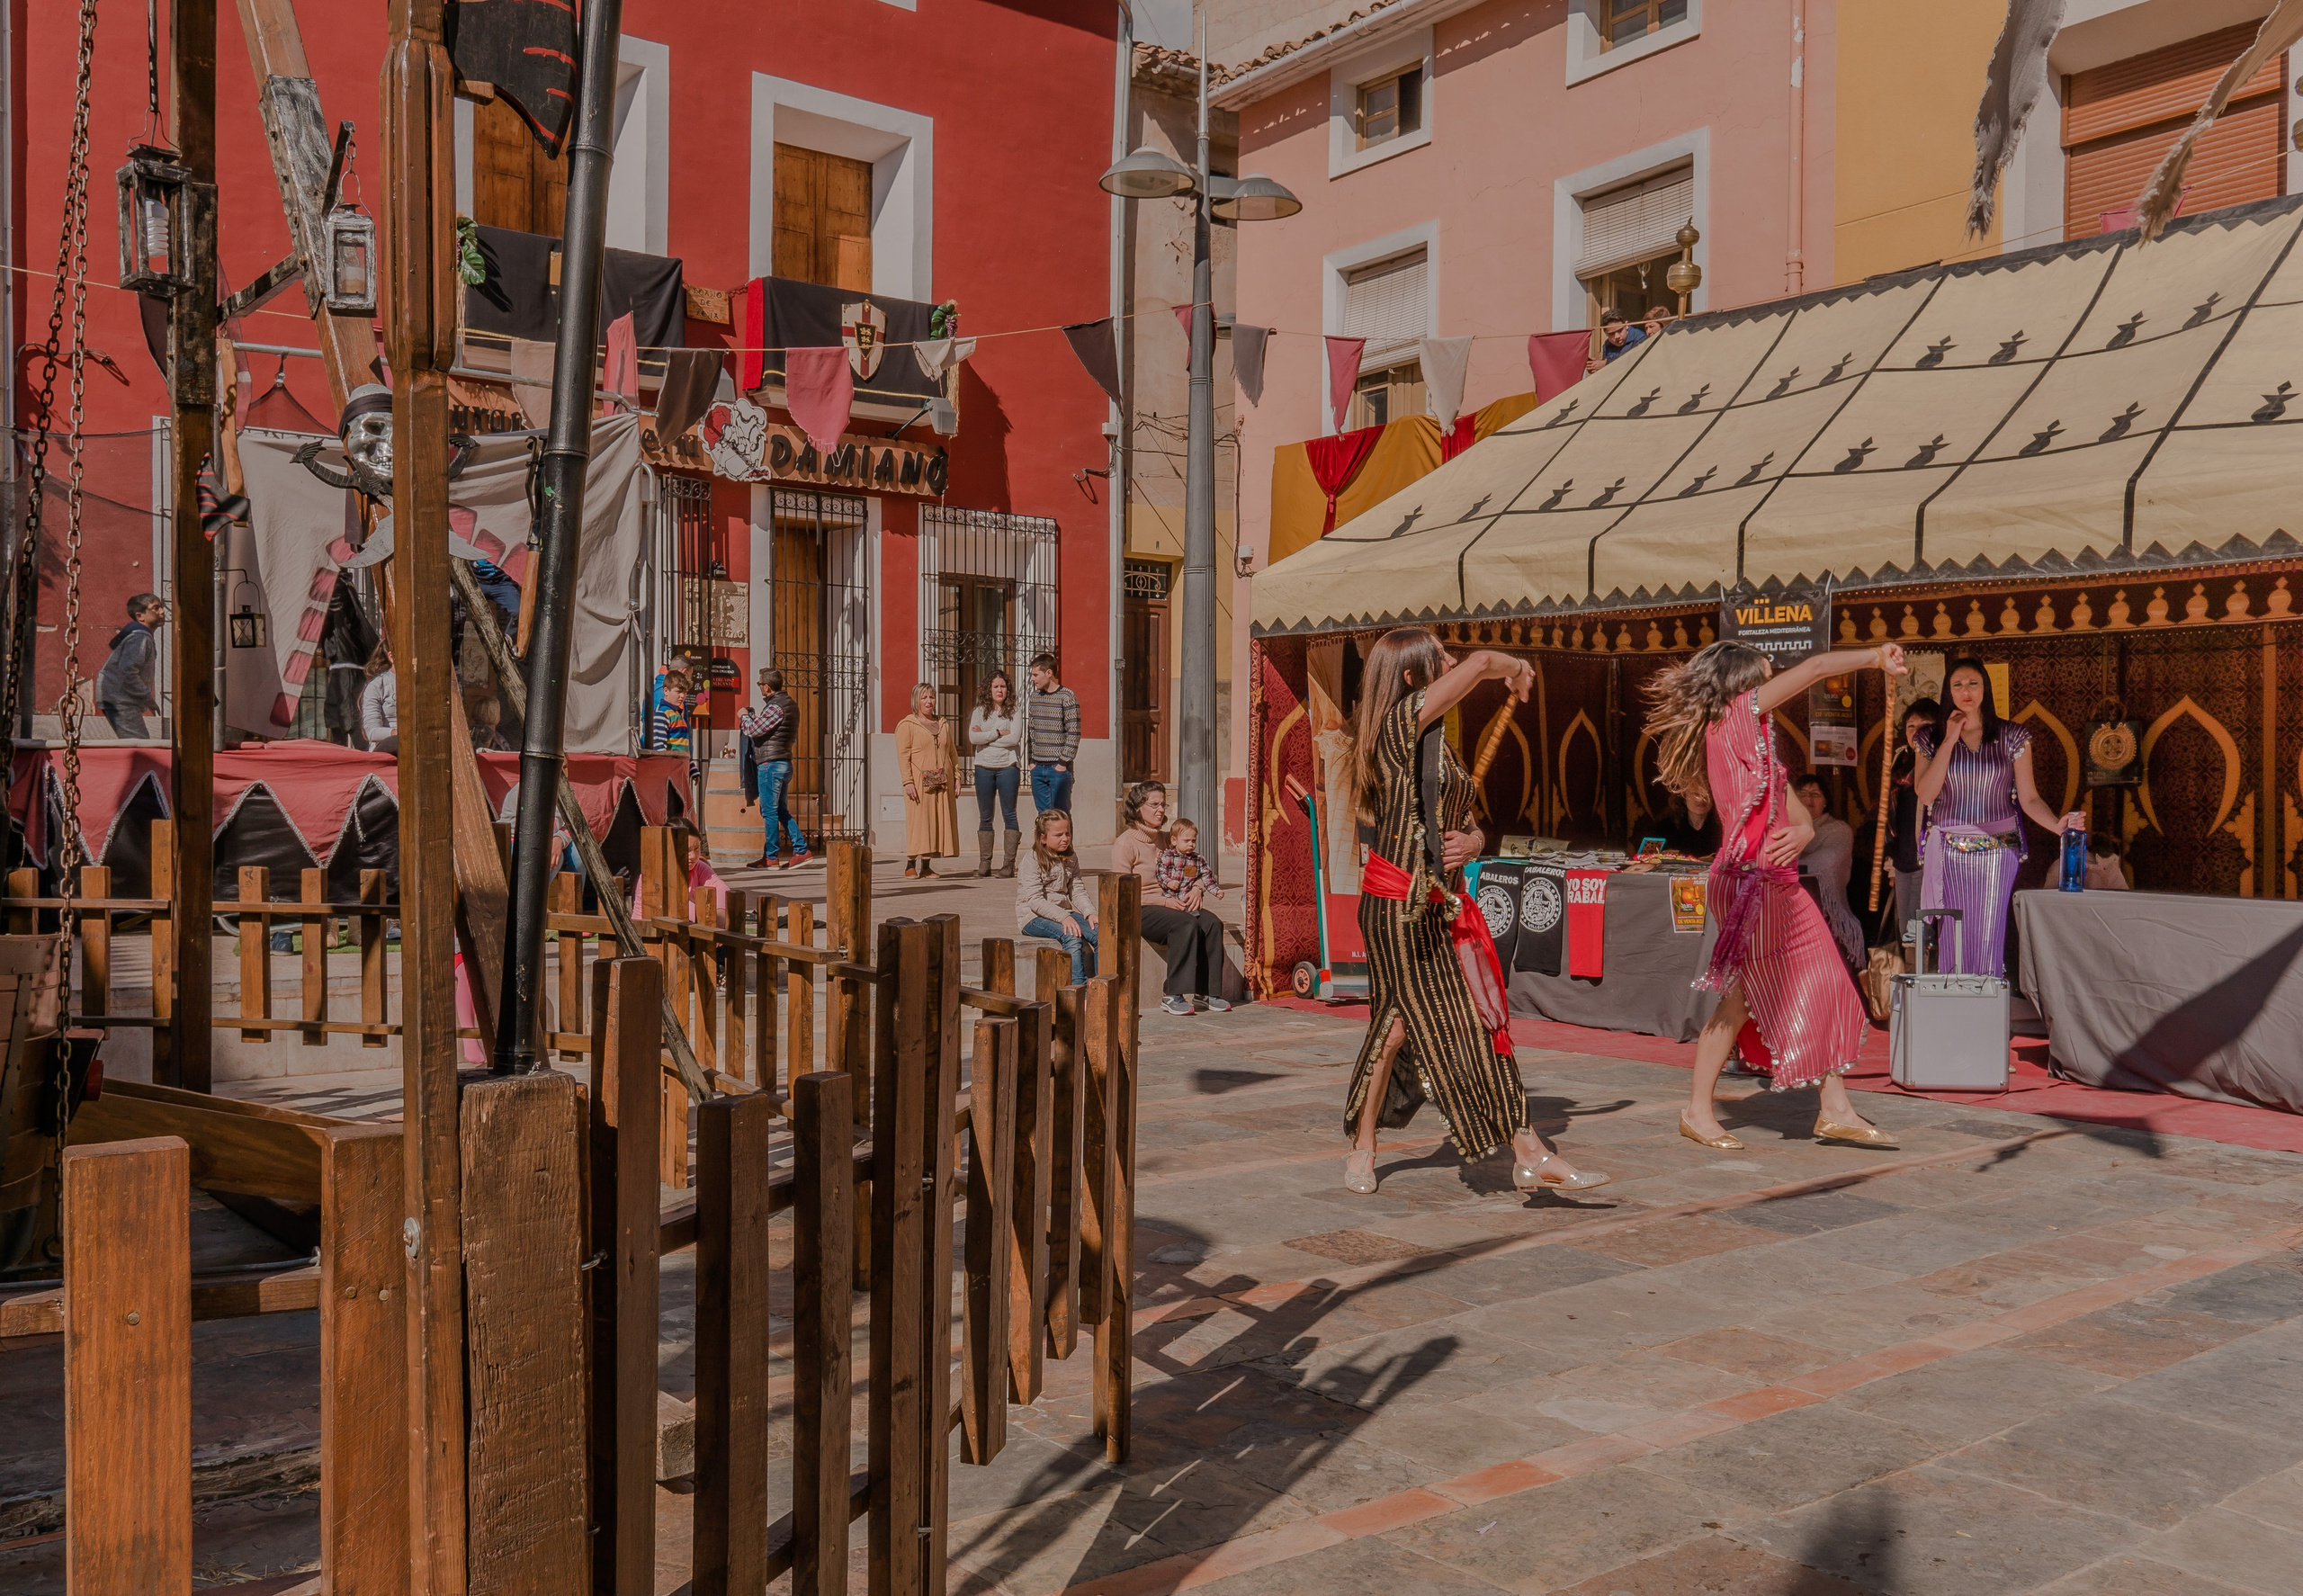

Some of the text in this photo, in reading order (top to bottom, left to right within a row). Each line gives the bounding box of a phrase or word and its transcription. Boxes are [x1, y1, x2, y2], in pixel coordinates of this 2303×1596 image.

[770, 434, 949, 489] DAMIANO
[1735, 604, 1813, 625] VILLENA
[1738, 628, 1770, 636] FORTALEZA
[1480, 871, 1519, 884] ABALEROS
[1566, 877, 1607, 892] YO SOY
[1567, 891, 1605, 903] RABAL
